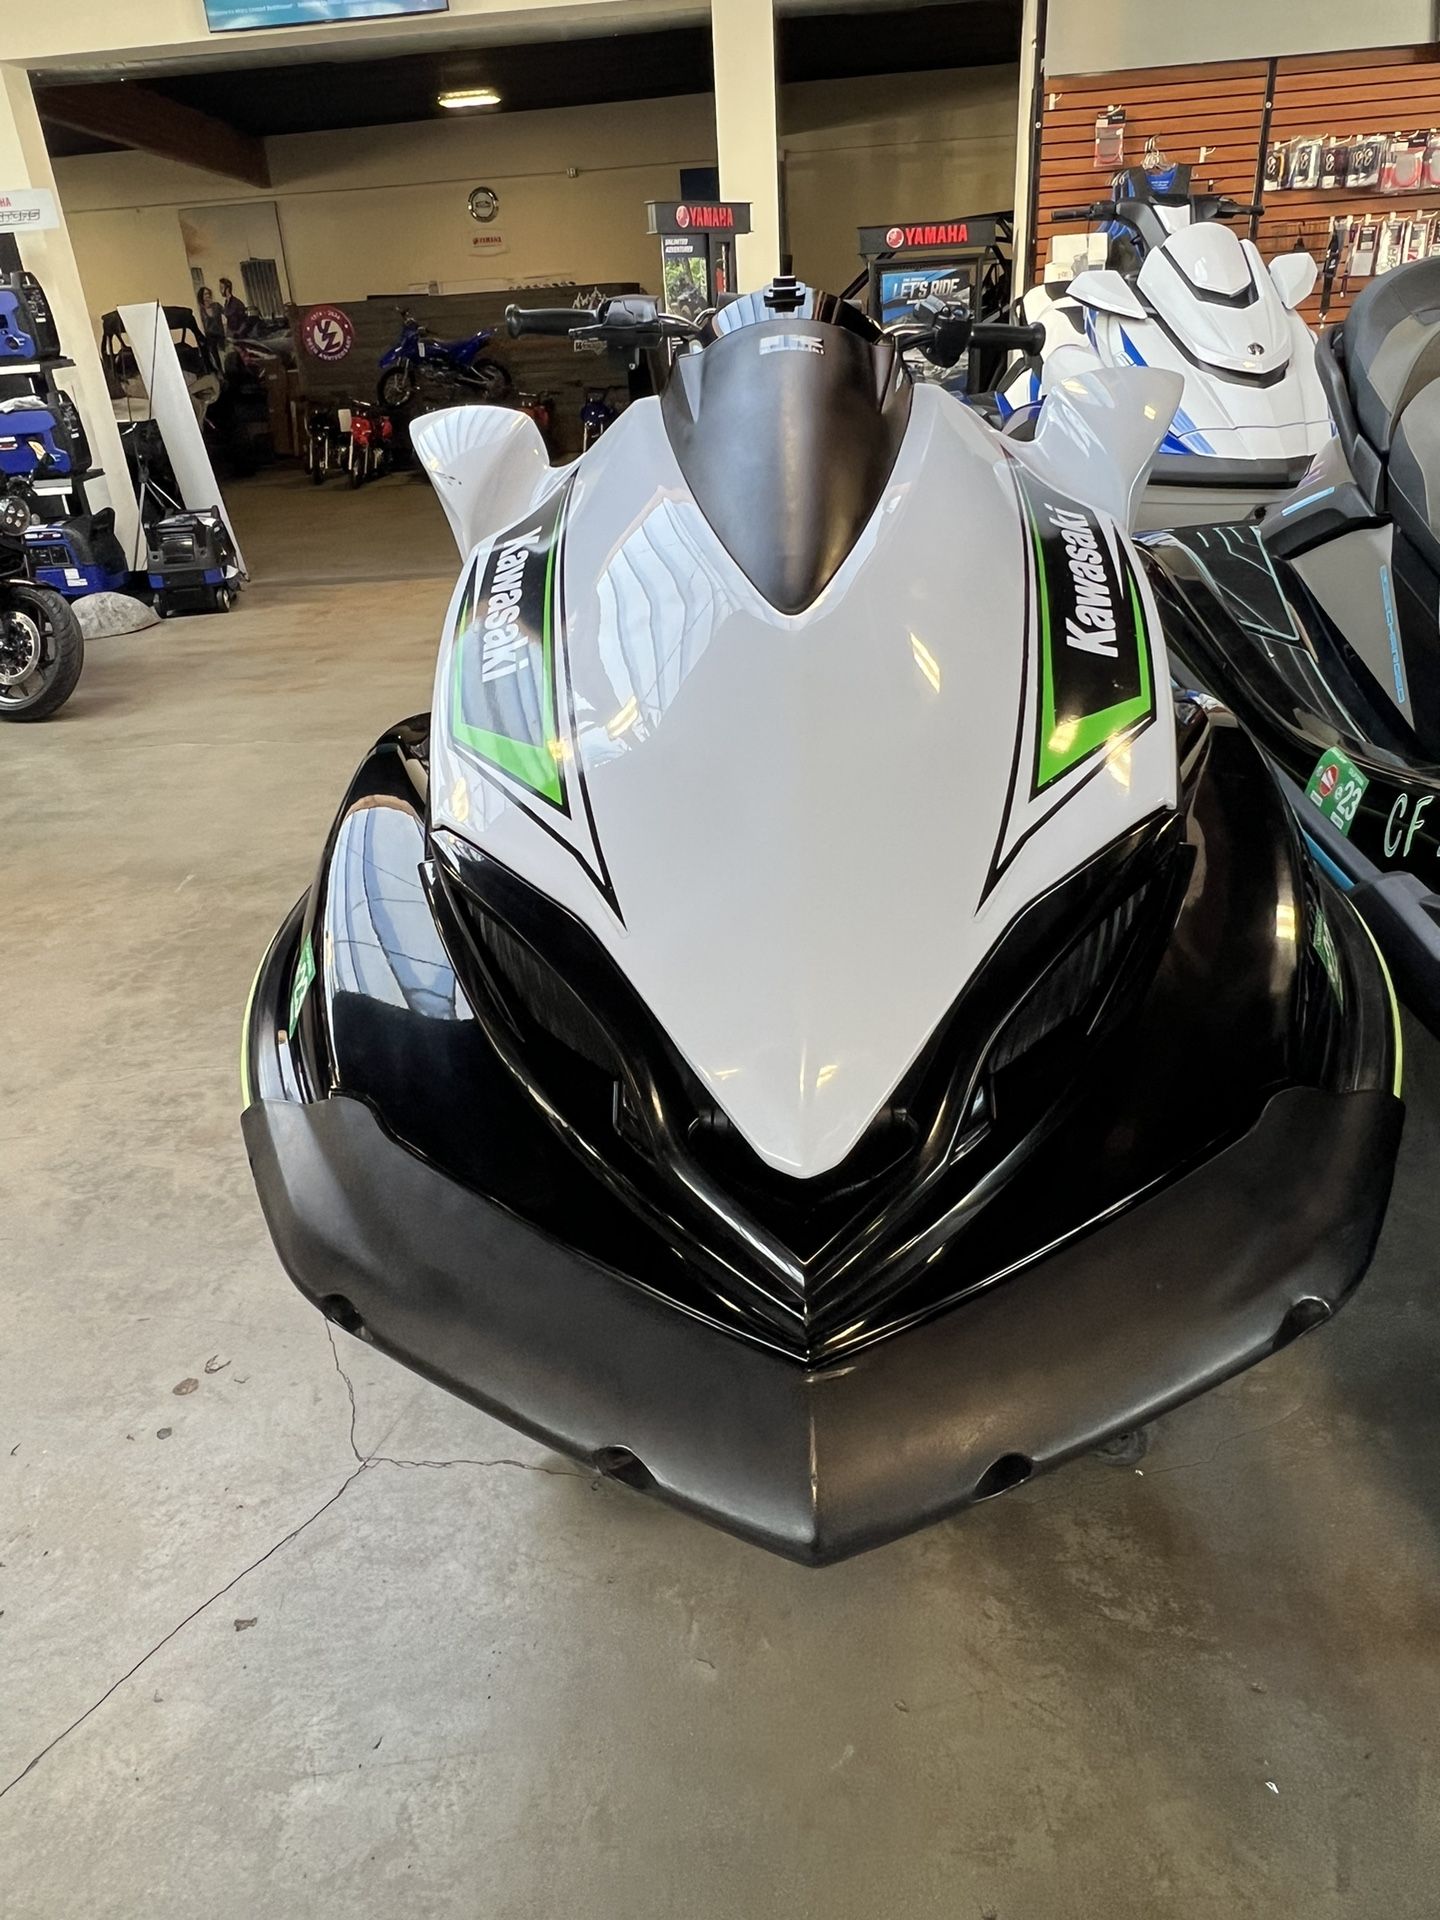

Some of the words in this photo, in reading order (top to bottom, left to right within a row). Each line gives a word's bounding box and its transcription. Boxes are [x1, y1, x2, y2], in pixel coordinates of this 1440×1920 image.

[689, 206, 734, 227] YAMAHA
[905, 224, 968, 246] YAMAHA
[892, 282, 929, 299] LET'S
[930, 278, 960, 297] RIDE
[315, 319, 341, 351] YZ
[1043, 502, 1119, 658] Kawasaki
[482, 525, 543, 683] Kawasaki
[1336, 780, 1363, 821] 23
[1383, 792, 1435, 858] CF
